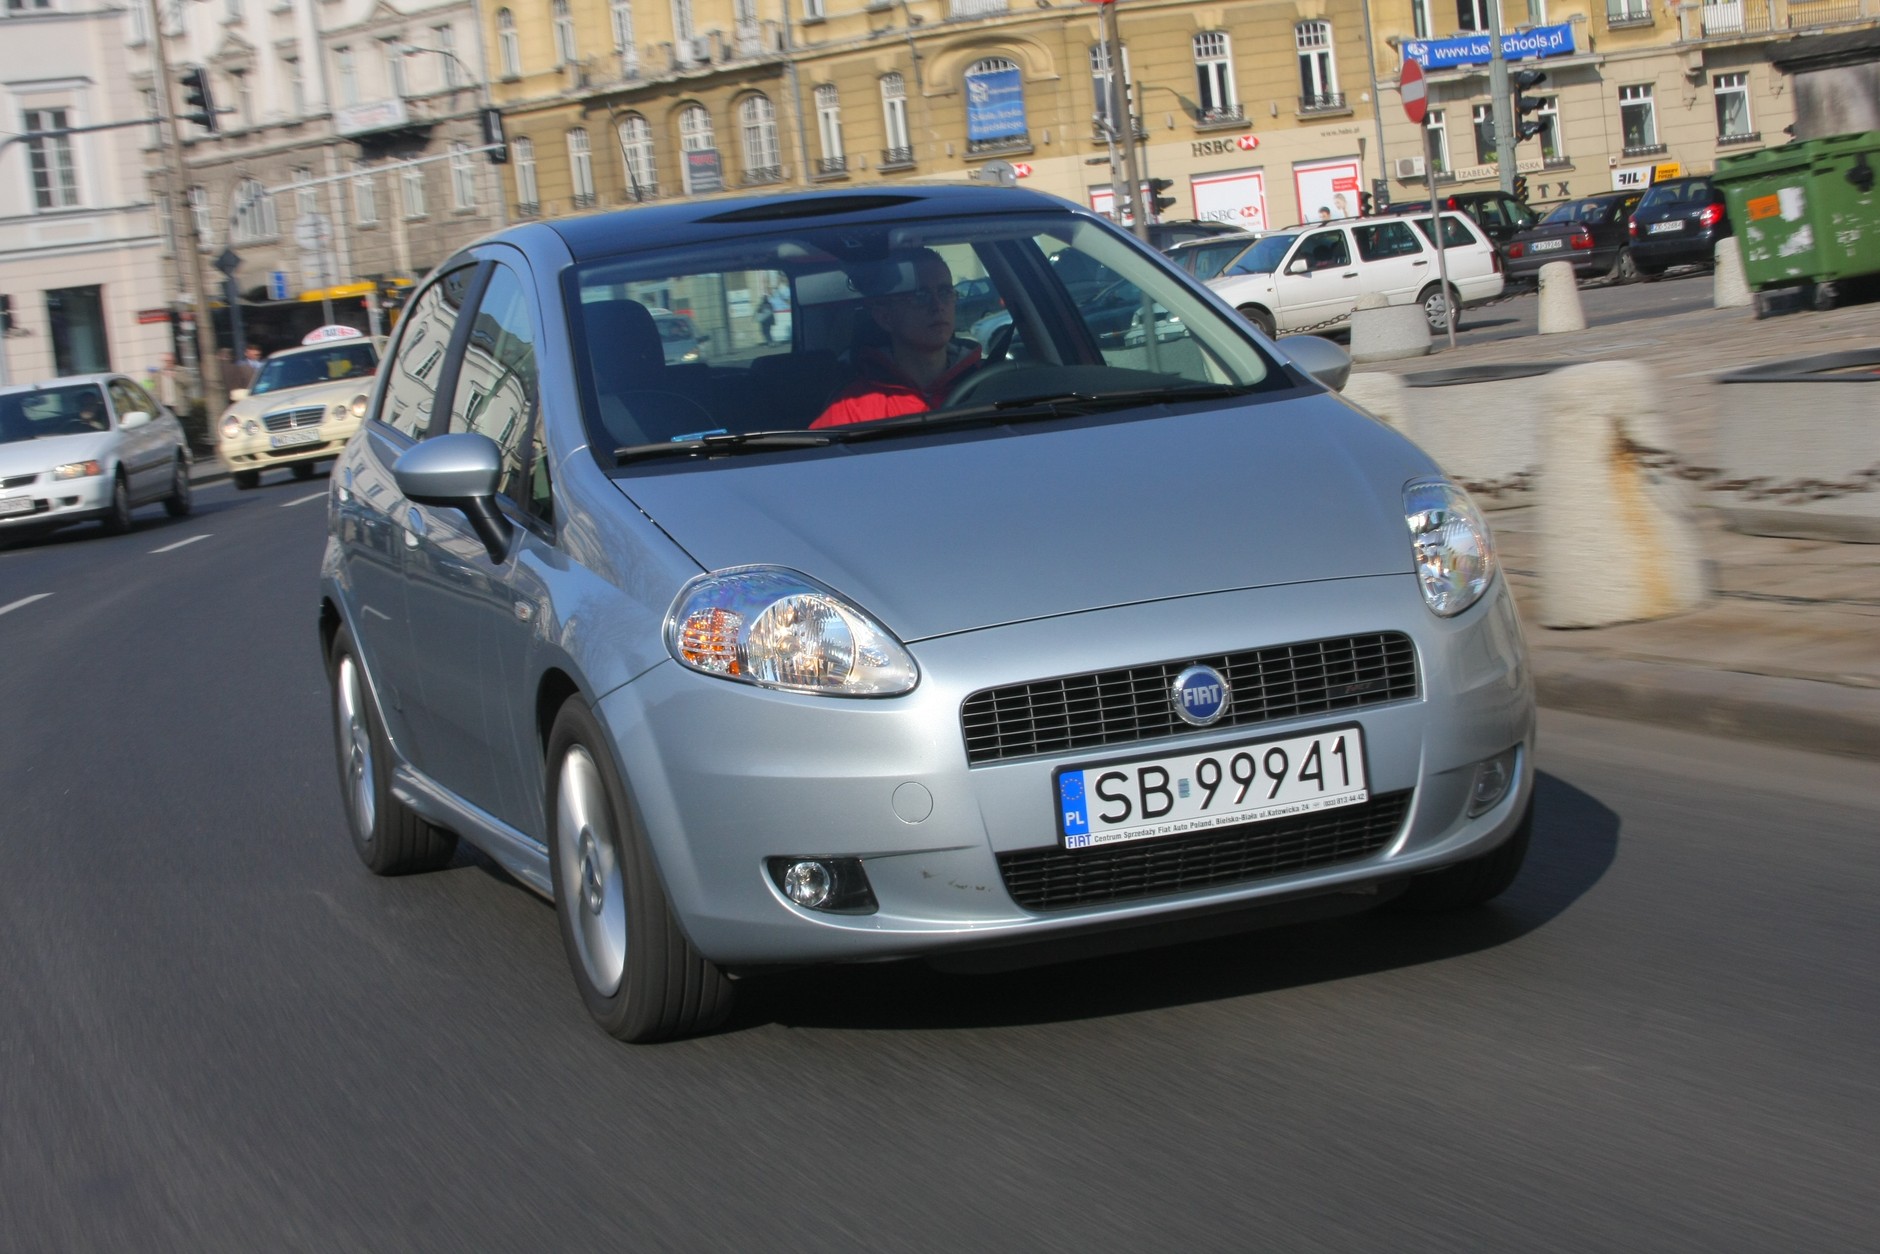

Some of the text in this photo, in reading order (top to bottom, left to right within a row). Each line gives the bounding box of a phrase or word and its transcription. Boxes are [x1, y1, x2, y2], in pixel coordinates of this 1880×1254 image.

[1434, 31, 1563, 59] www.belchools.pl
[1191, 139, 1235, 158] HSBC
[1458, 168, 1491, 179] IZABELA
[1201, 207, 1237, 221] HSBC
[1183, 684, 1219, 707] FIAT
[1095, 736, 1349, 824] SB 99941
[1065, 811, 1085, 826] PL
[1094, 833, 1122, 843] Centrum
[1124, 828, 1155, 839] Sprzedaży
[1158, 825, 1171, 834] Fiat
[1173, 823, 1188, 831] Auto
[1190, 819, 1214, 829] Poland,
[1301, 803, 1309, 811] 24
[1067, 834, 1091, 848] FIAT
